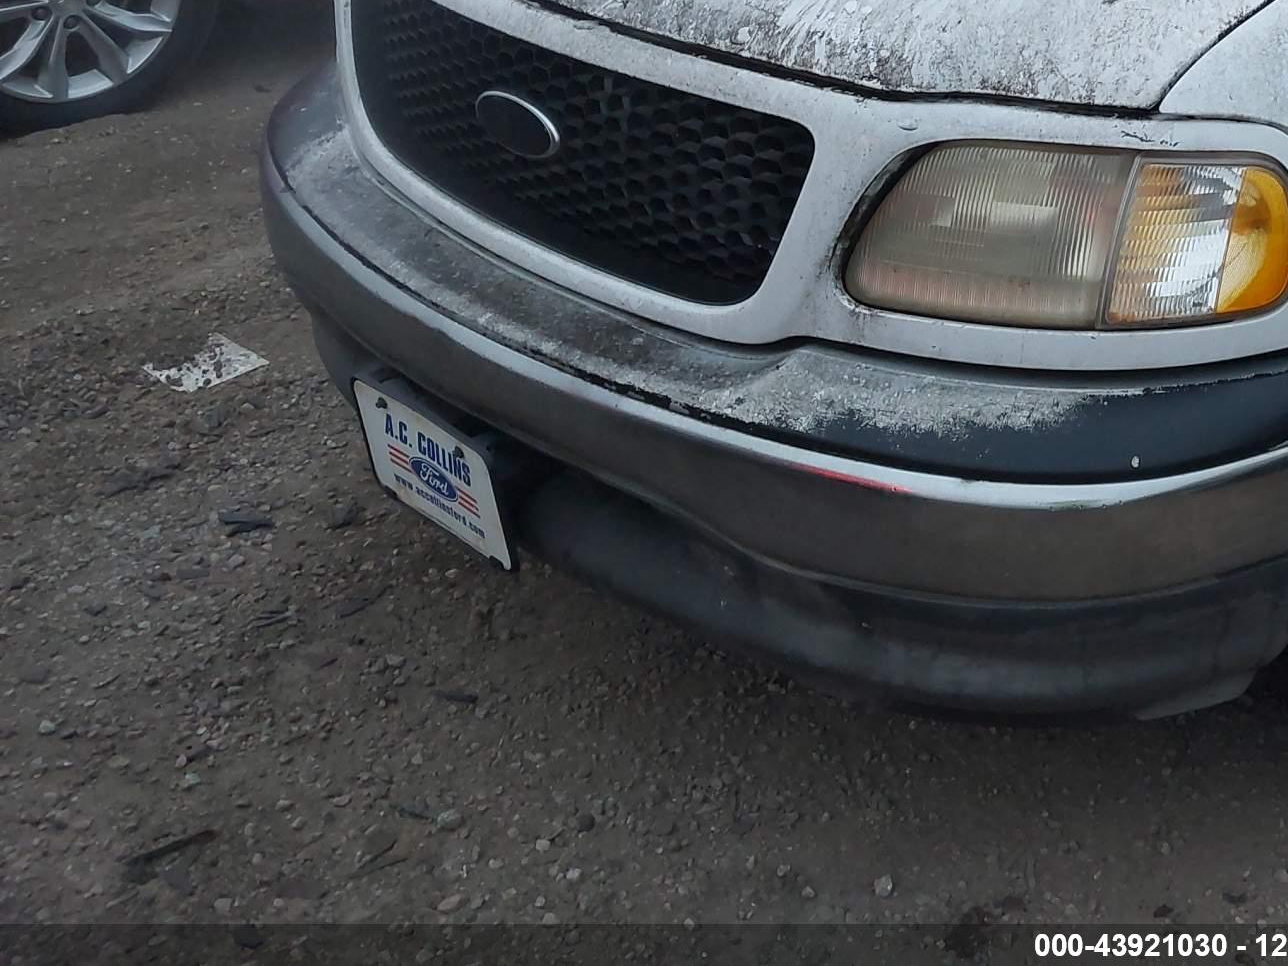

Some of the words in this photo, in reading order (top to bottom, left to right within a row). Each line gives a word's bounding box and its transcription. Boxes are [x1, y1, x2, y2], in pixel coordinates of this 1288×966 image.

[385, 413, 413, 448] A.C.
[417, 432, 471, 486] COLLINS
[419, 462, 449, 496] Ford
